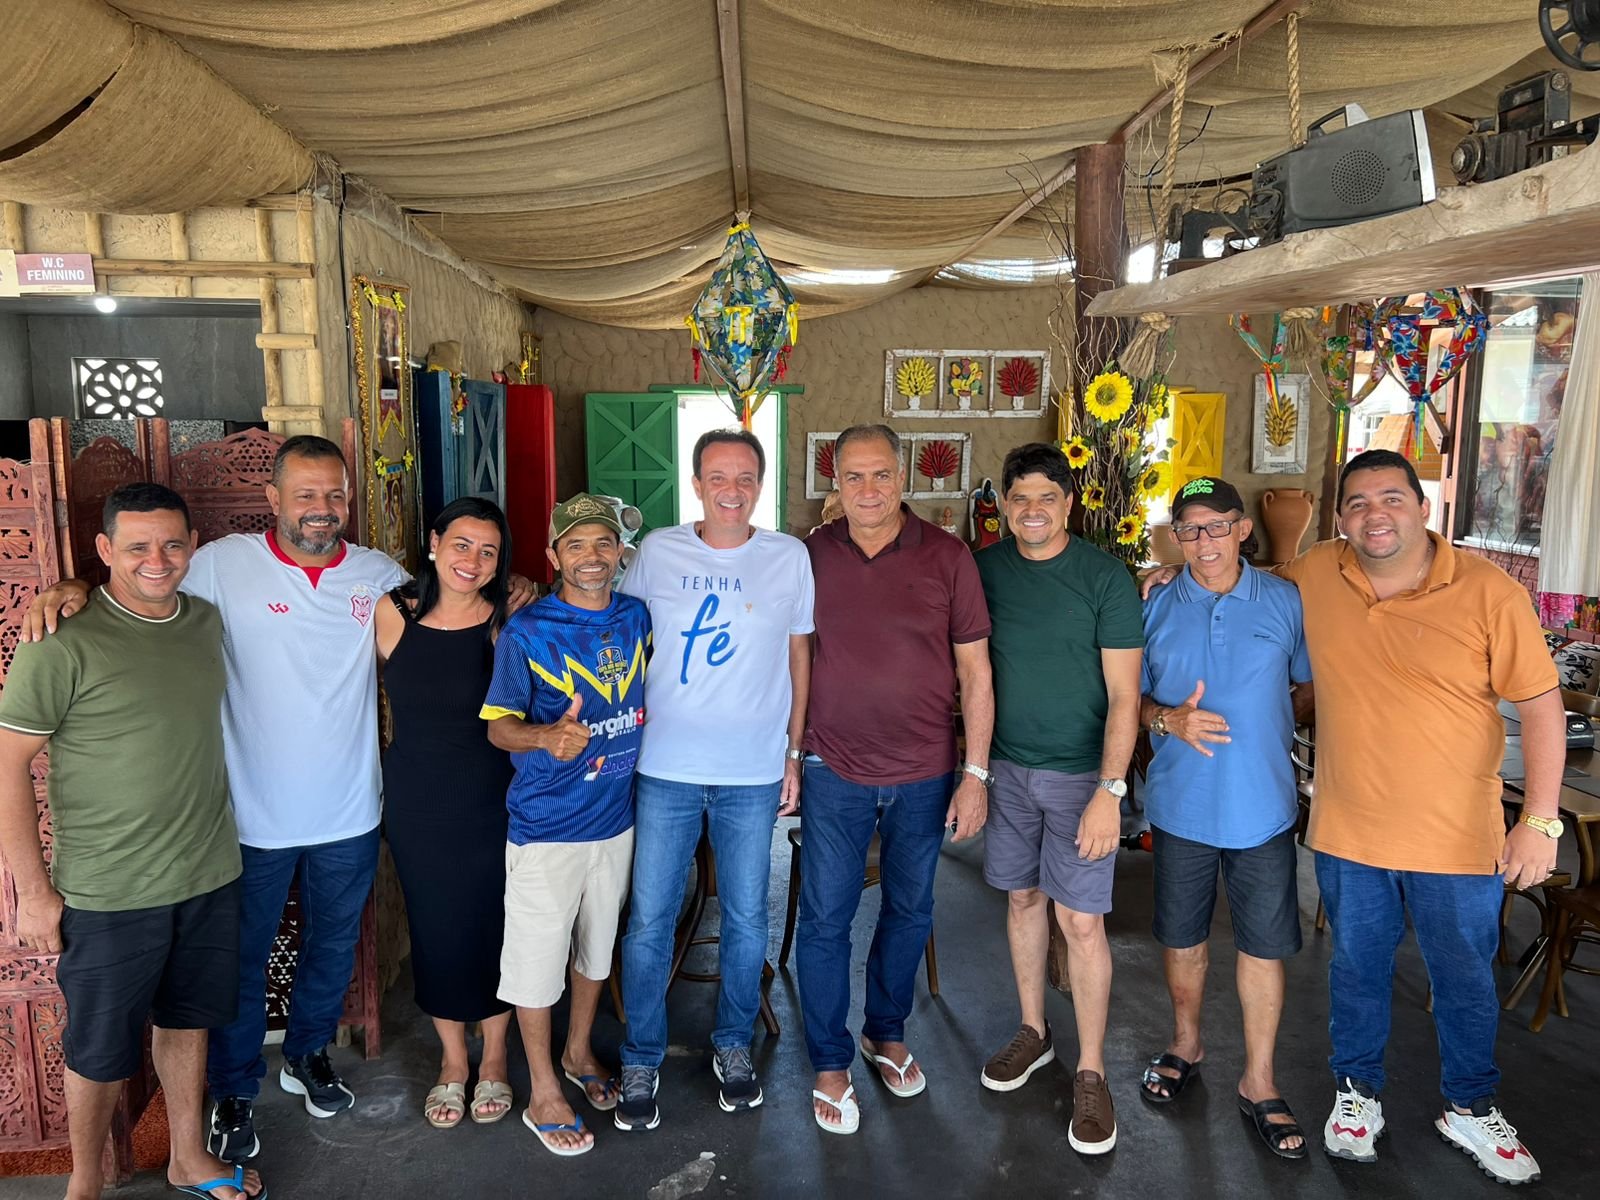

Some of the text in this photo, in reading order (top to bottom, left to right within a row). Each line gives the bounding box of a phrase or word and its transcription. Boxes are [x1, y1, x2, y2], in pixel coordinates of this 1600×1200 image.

[41, 257, 65, 268] W.C
[26, 269, 86, 281] FEMININO
[681, 575, 743, 593] TENHA
[680, 593, 740, 685] fé
